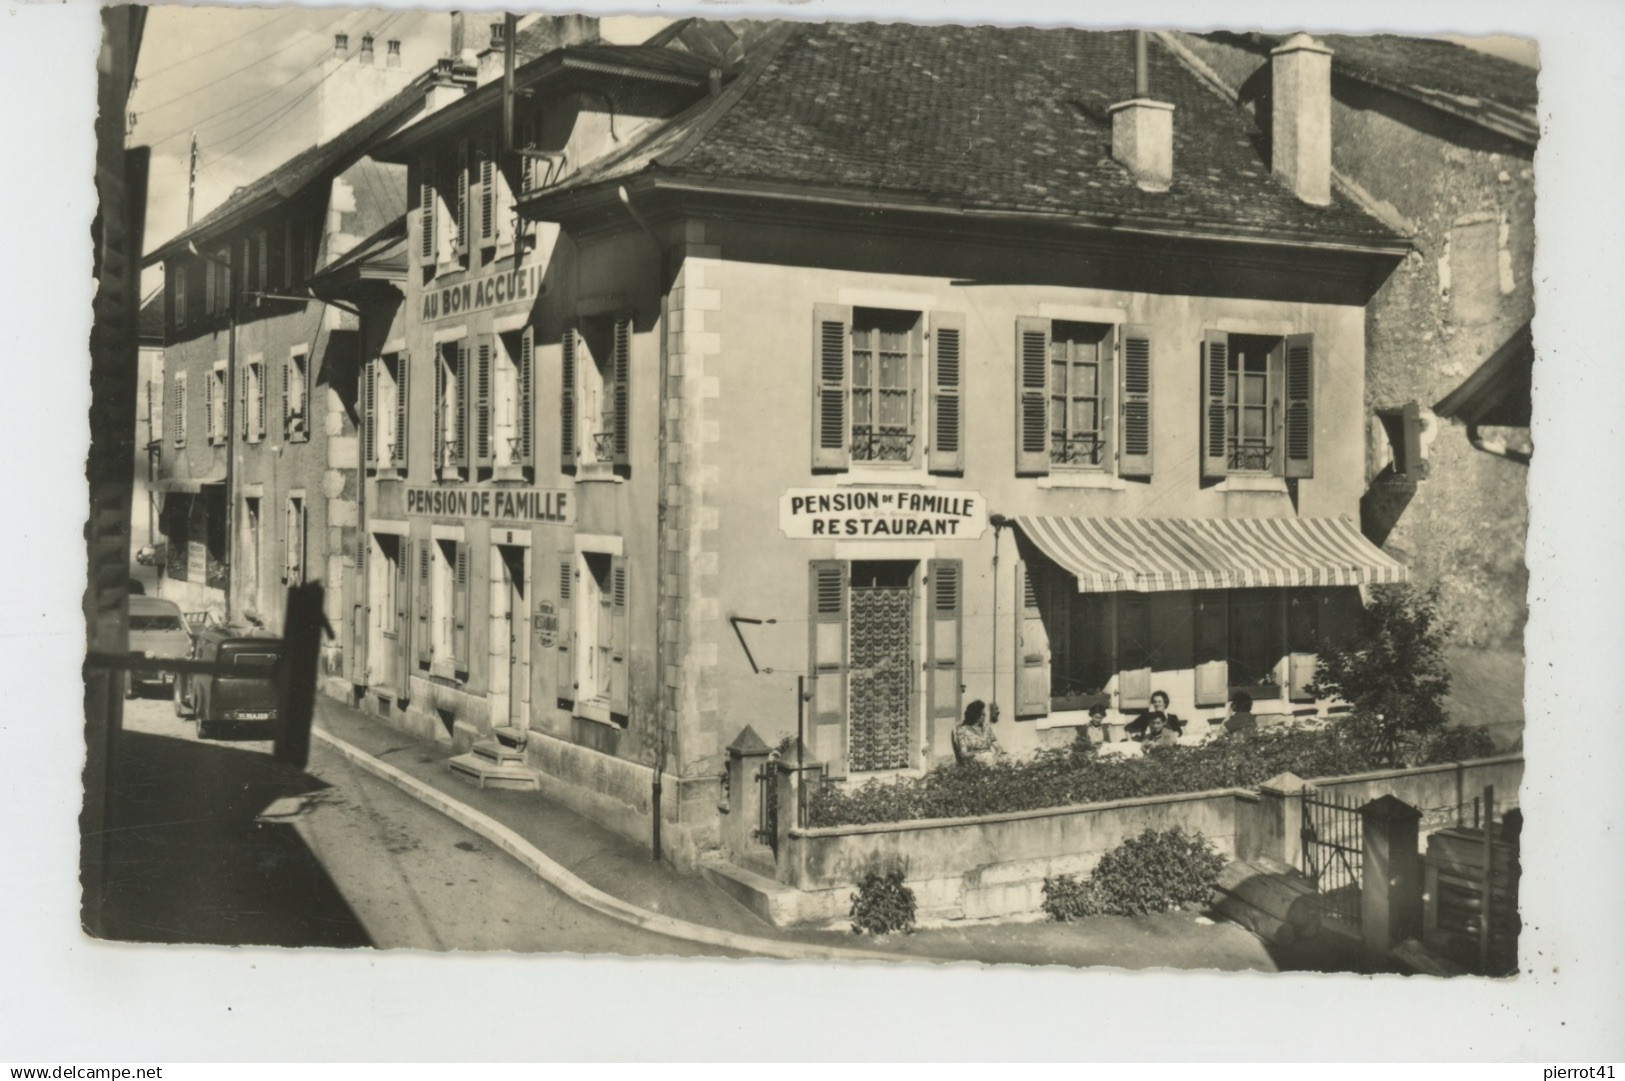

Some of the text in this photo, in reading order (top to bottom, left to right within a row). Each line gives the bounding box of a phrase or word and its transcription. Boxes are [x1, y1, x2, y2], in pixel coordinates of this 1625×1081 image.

[423, 291, 438, 320] AU
[442, 283, 471, 316] BON
[408, 489, 567, 523] PENSION DE FAMILLE
[791, 491, 974, 517] PENSION DE FAMILLE
[812, 519, 960, 535] RESTAURANT
